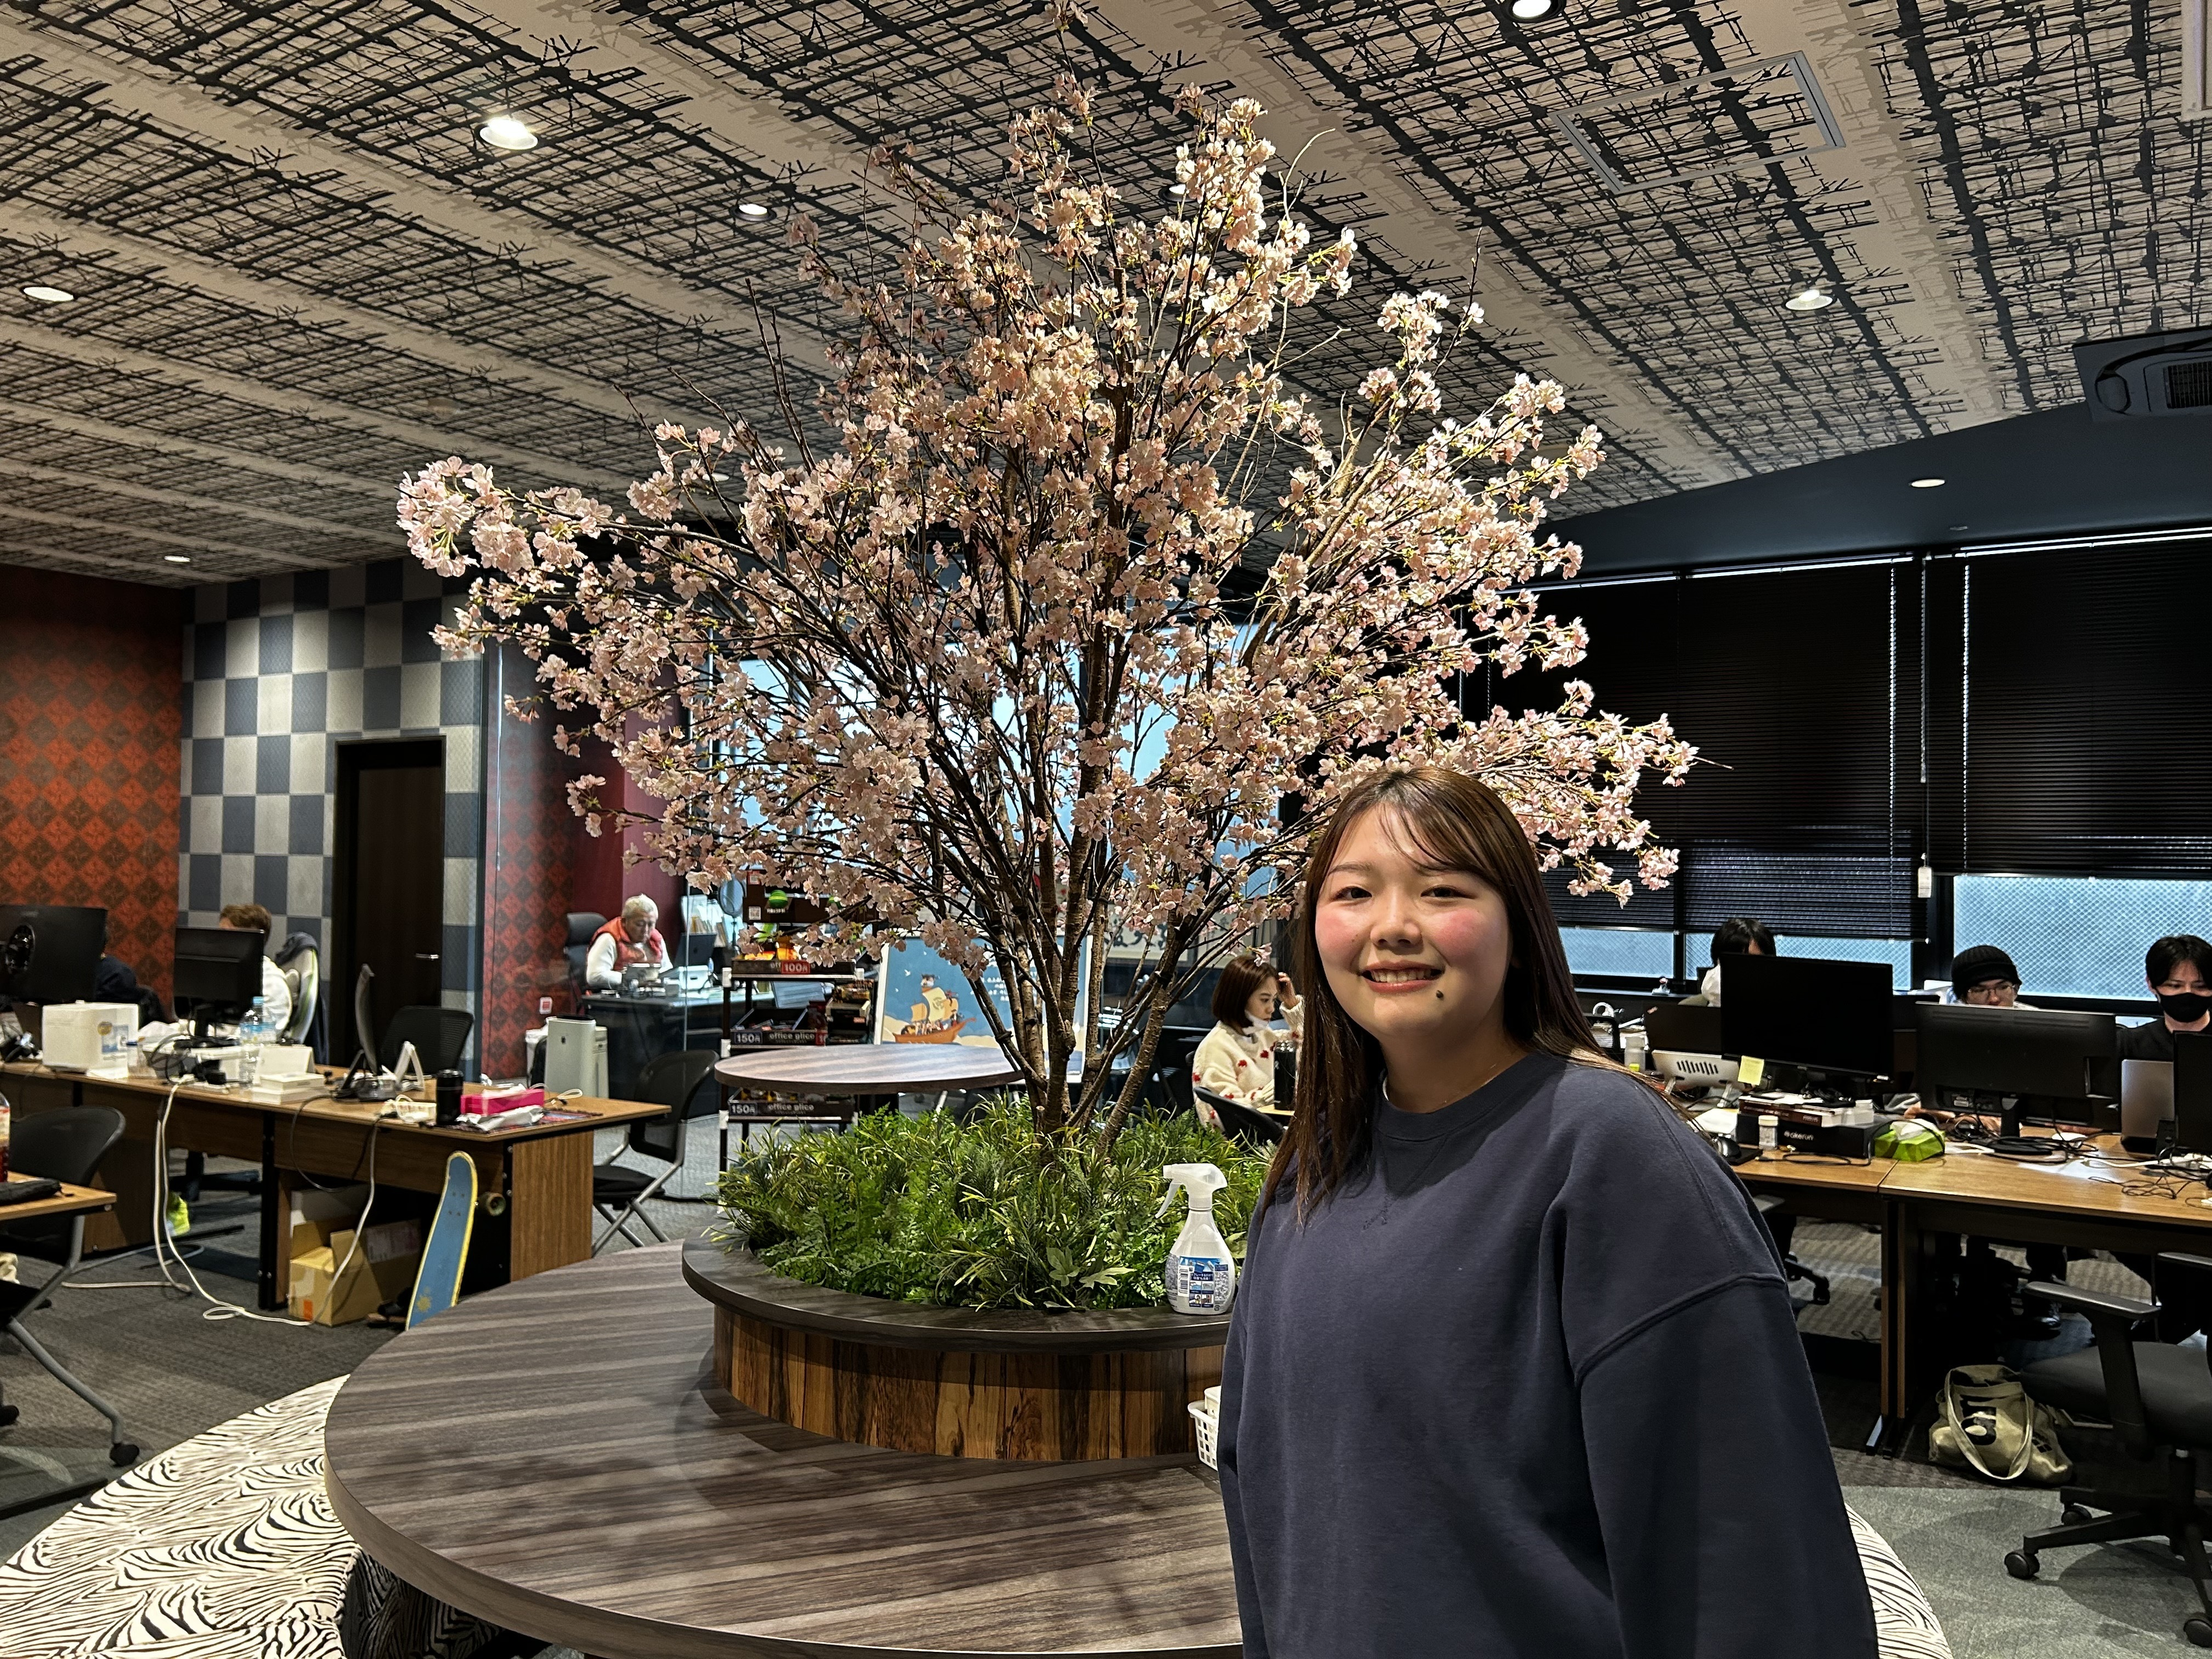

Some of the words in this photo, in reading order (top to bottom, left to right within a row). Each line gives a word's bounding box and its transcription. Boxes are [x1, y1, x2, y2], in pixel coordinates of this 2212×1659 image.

[785, 962, 808, 972] 100円
[736, 1033, 761, 1043] 150円
[1789, 1131, 1814, 1141] akerun
